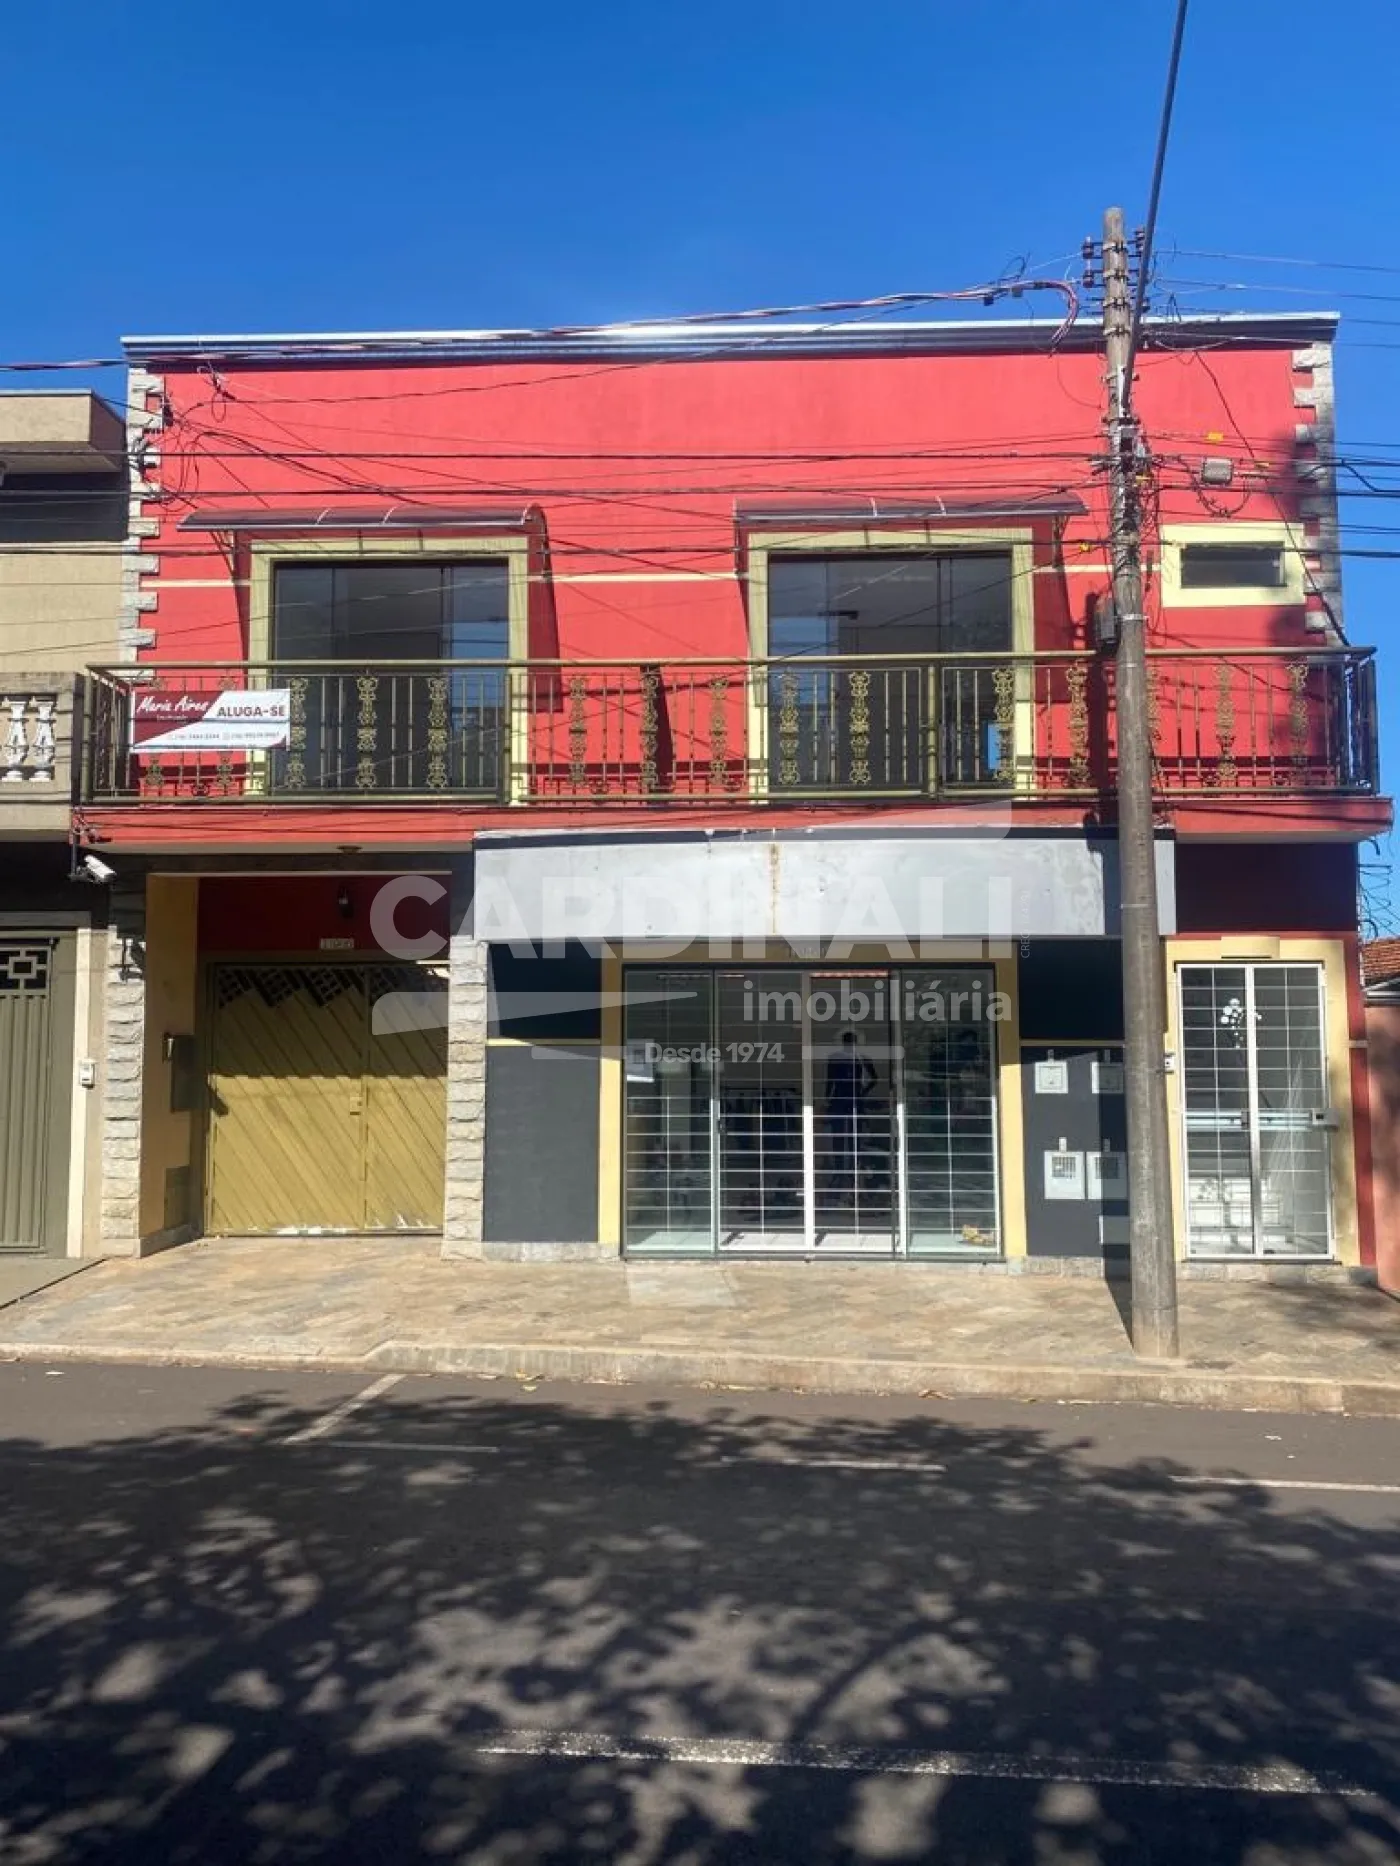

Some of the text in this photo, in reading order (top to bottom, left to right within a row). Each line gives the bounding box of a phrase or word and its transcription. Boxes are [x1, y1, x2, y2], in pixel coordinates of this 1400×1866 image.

[136, 695, 209, 713] Maria Aires
[216, 705, 286, 718] ALUGA-SE
